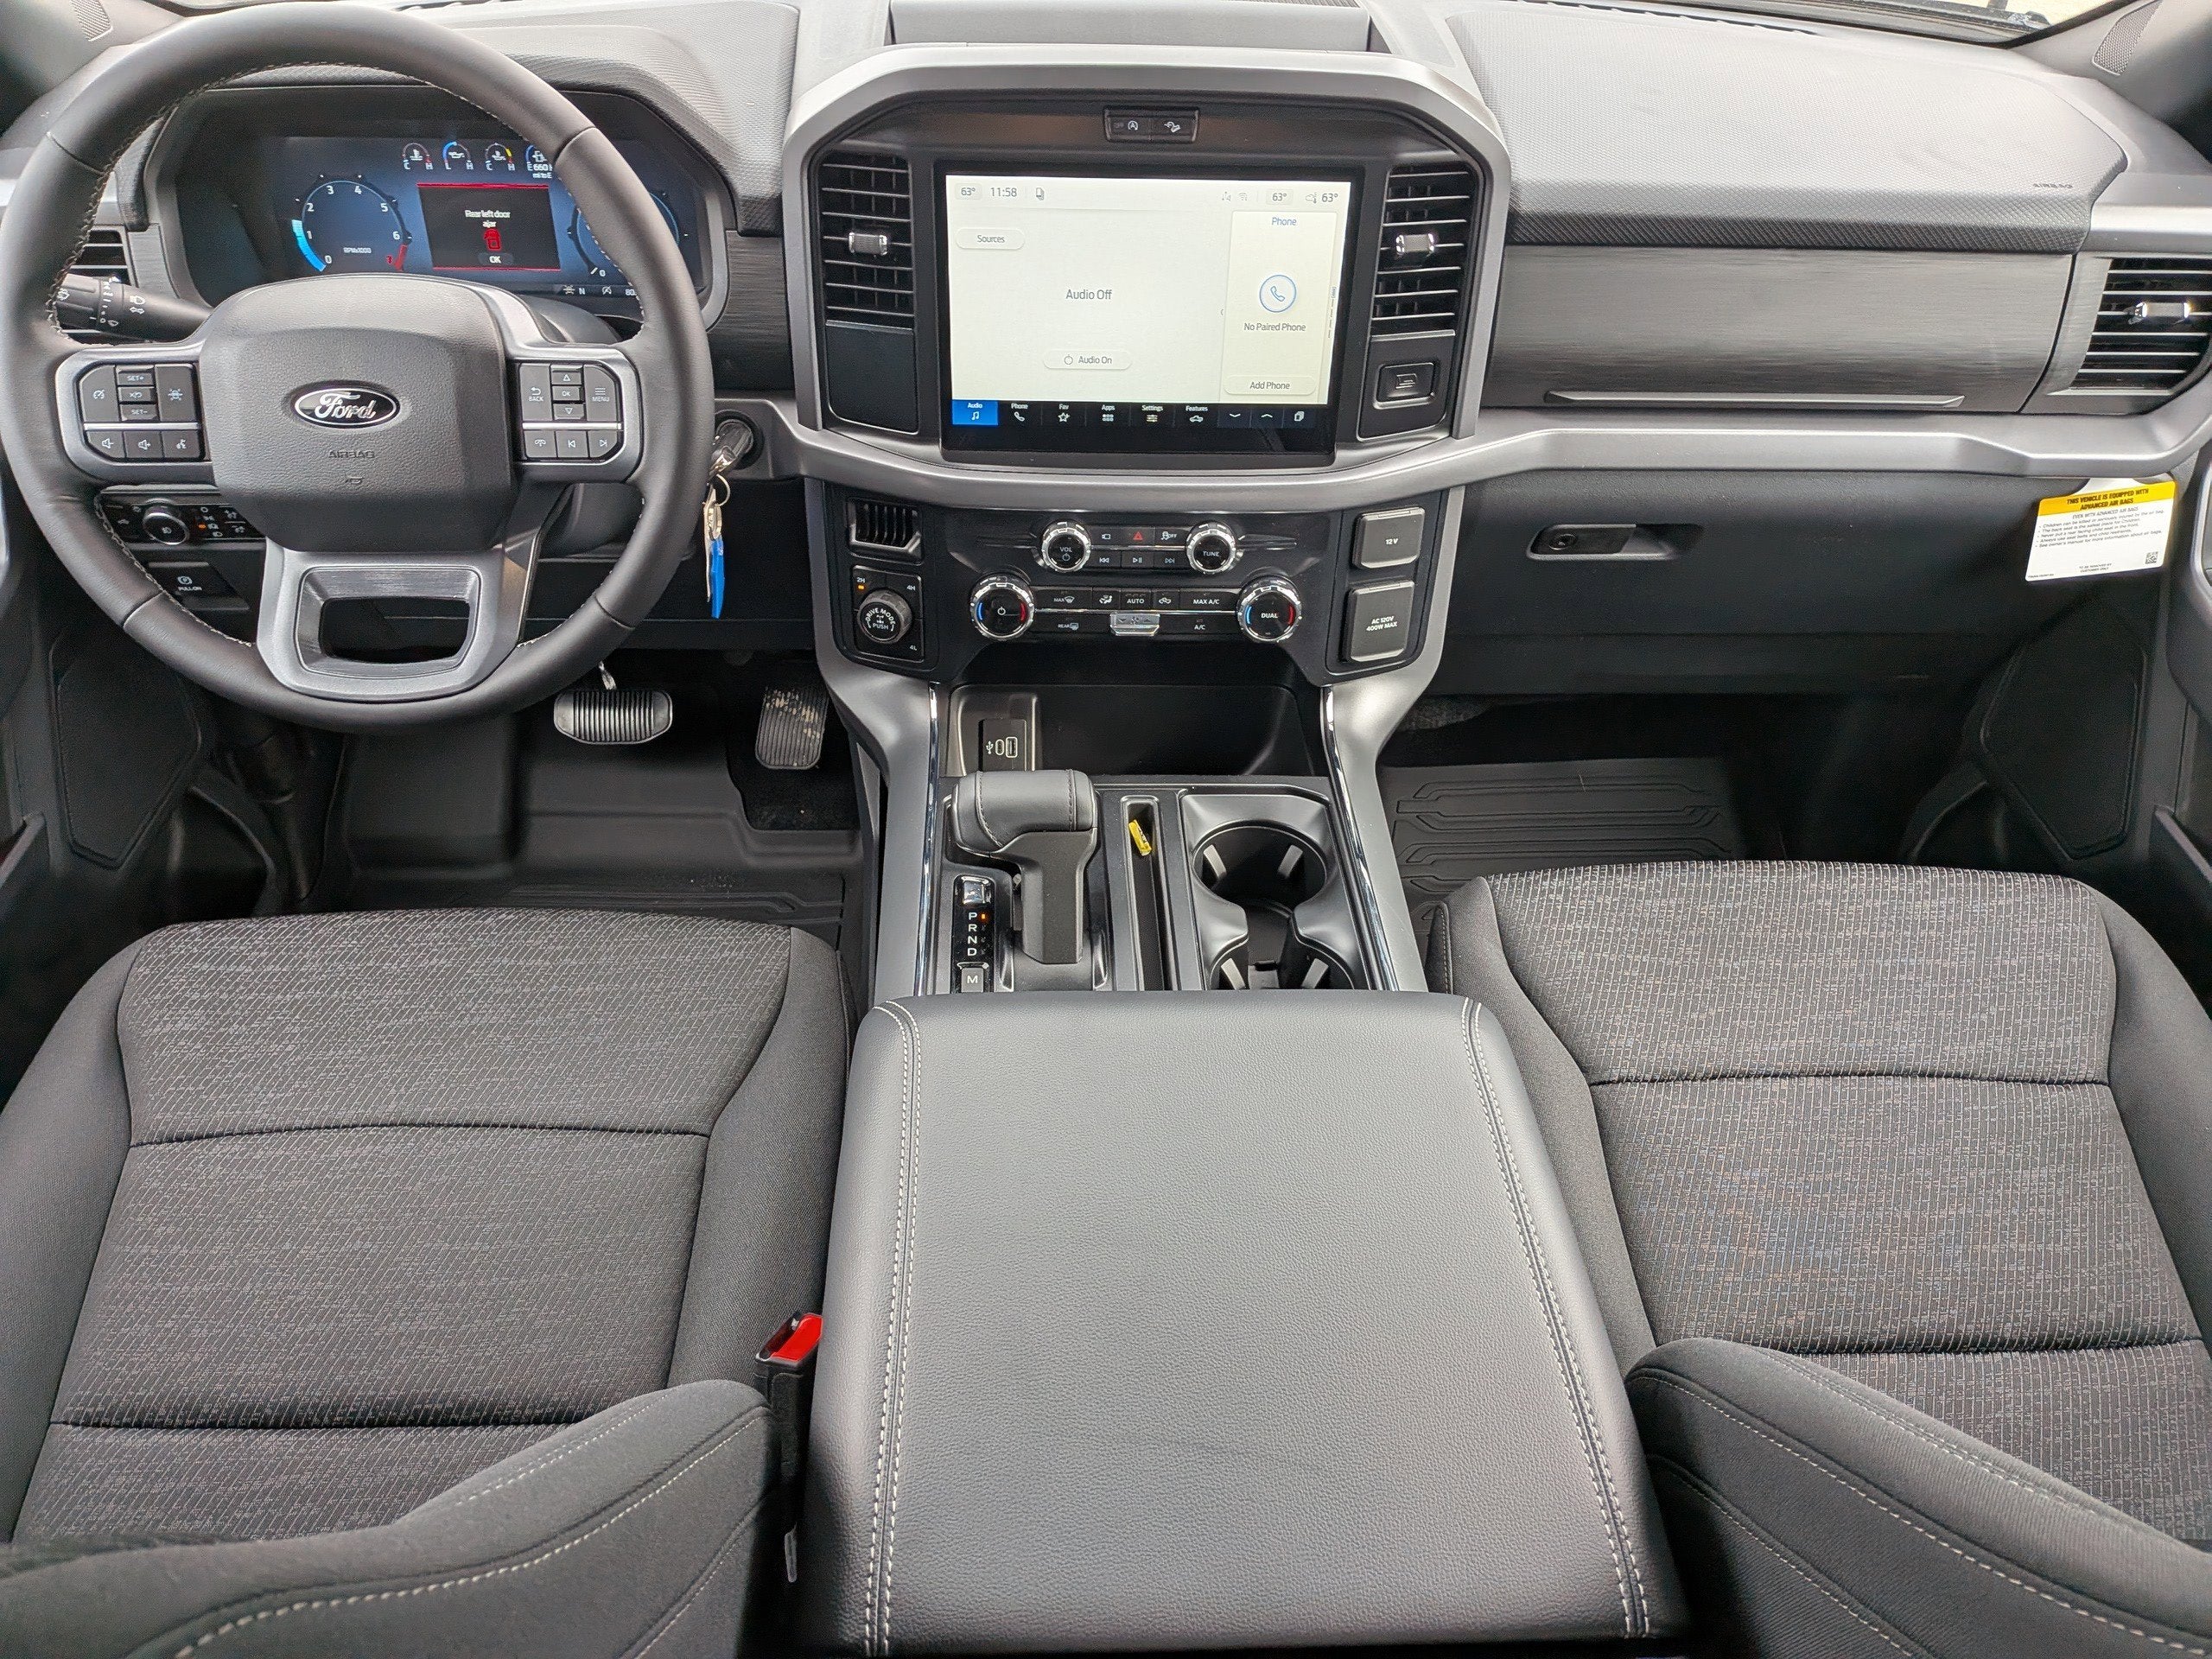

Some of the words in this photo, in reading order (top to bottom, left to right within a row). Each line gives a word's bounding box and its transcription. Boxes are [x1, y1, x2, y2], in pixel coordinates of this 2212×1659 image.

[327, 186, 334, 194] 3
[354, 186, 362, 194] 4
[990, 188, 1017, 197] 11:58
[307, 202, 315, 212] 2
[380, 203, 389, 213] 5
[465, 209, 481, 218] Rear
[481, 209, 494, 218] left
[482, 219, 497, 228] ajar
[1271, 217, 1297, 226] Phone
[307, 230, 313, 239] 1
[392, 231, 400, 240] 6
[977, 234, 1006, 243] Sources
[324, 255, 332, 264] 0
[1065, 289, 1095, 300] Audio
[1096, 289, 1113, 300] Off
[1244, 322, 1255, 331] No
[1255, 322, 1281, 331] Paired
[1281, 322, 1306, 332] Phone
[1078, 355, 1100, 364] Audio
[1249, 381, 1265, 390] Add
[315, 392, 377, 419] Ford
[328, 450, 375, 459] AIRBAG
[2080, 494, 2101, 503] VEHICLE
[2109, 490, 2134, 499] EQUIPPED
[2080, 501, 2108, 511] ADVANCED
[865, 607, 880, 622] DRIVE
[880, 608, 896, 625] MODE
[1366, 623, 1383, 632] 400W
[969, 924, 977, 932] R
[968, 936, 977, 944] N
[968, 948, 977, 957] D
[967, 975, 978, 984] M
